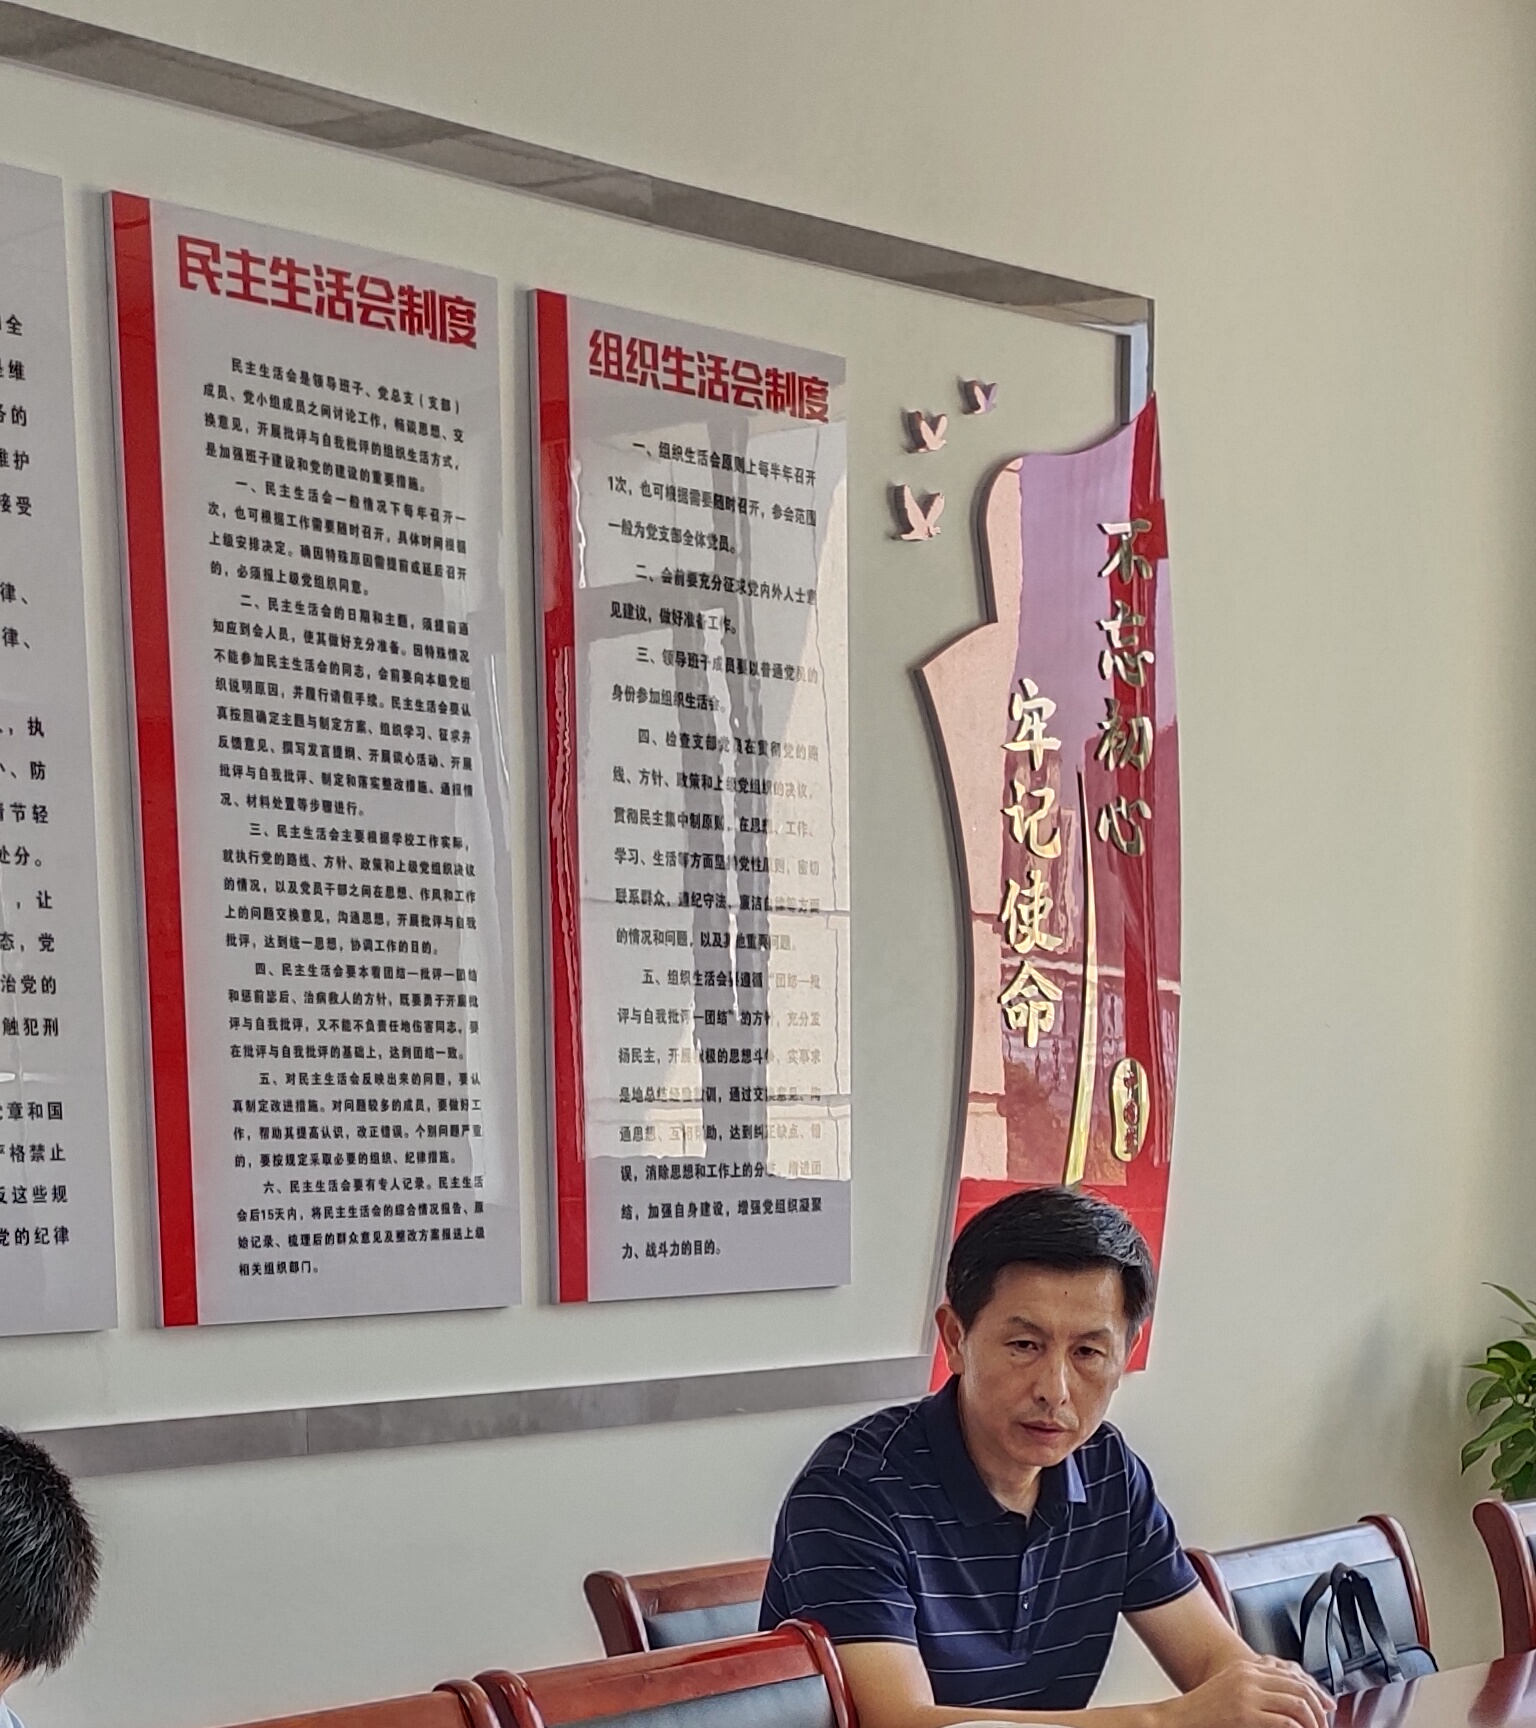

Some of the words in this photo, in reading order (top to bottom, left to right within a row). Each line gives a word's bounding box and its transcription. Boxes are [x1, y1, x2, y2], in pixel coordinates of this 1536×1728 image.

[177, 234, 477, 350] 民主生活会制度
[589, 329, 829, 424] 组织生活会制度
[1097, 519, 1154, 858] 不忘初心
[999, 677, 1064, 1050] 牢记使命
[239, 1261, 319, 1277] 相关组织部门。
